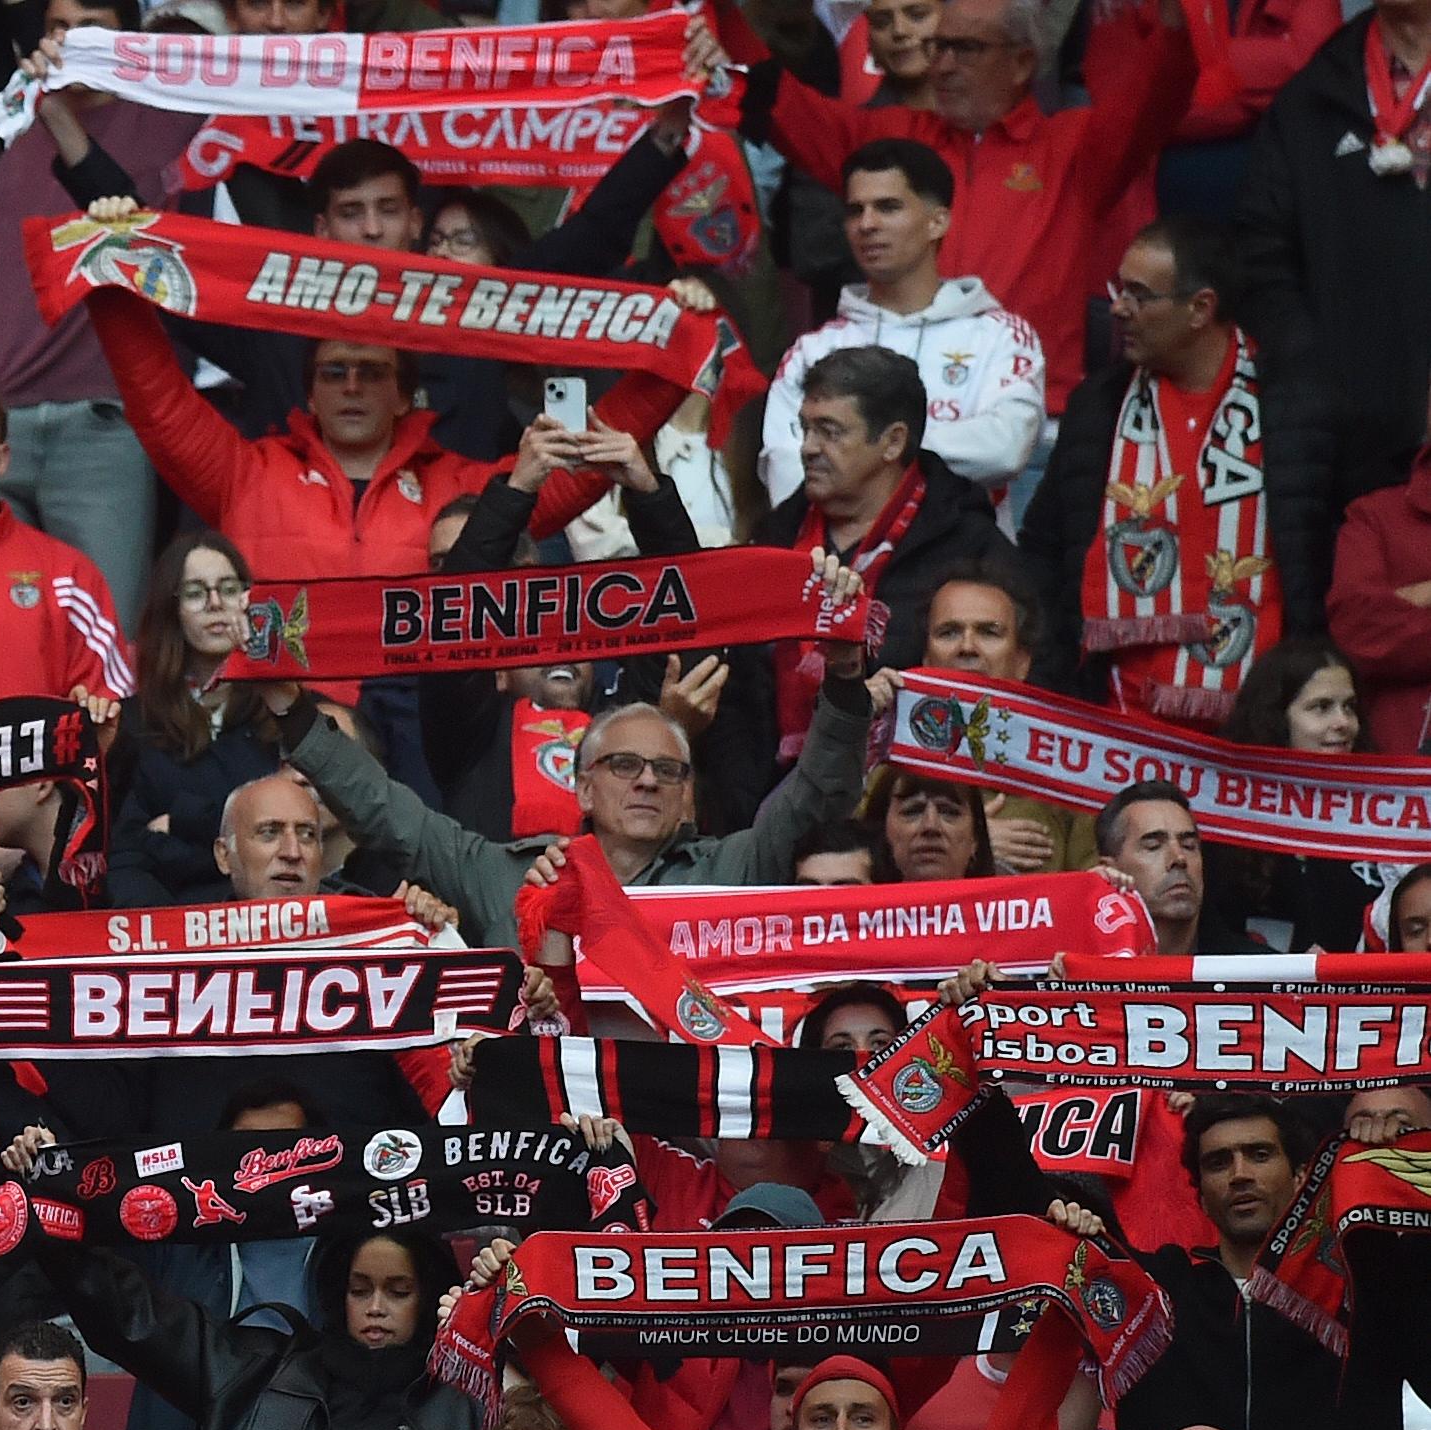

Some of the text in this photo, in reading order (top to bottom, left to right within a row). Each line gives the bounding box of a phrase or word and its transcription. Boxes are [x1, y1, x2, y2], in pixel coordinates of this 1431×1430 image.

[113, 33, 638, 91] SOU DO BENFICA
[248, 252, 679, 350] AMO-TE BENFICA
[380, 566, 697, 648] BENFICA
[1025, 726, 1094, 775] EU
[1214, 772, 1431, 831] BENFICA
[108, 900, 331, 952] S.L. BENFICA
[669, 896, 1055, 962] AMOR DA MINHA VIDA
[1048, 980, 1119, 995] Pluribus
[1126, 981, 1171, 995] Unum
[973, 1033, 1117, 1067] isboa
[444, 1131, 591, 1175] BENFICA
[369, 1180, 432, 1229] SLB
[476, 1193, 532, 1218] SLB
[1270, 1195, 1309, 1255] SPORT
[574, 1232, 1009, 1303] BENFICA
[797, 1324, 831, 1344] DO
[837, 1323, 920, 1344] MUNDO
